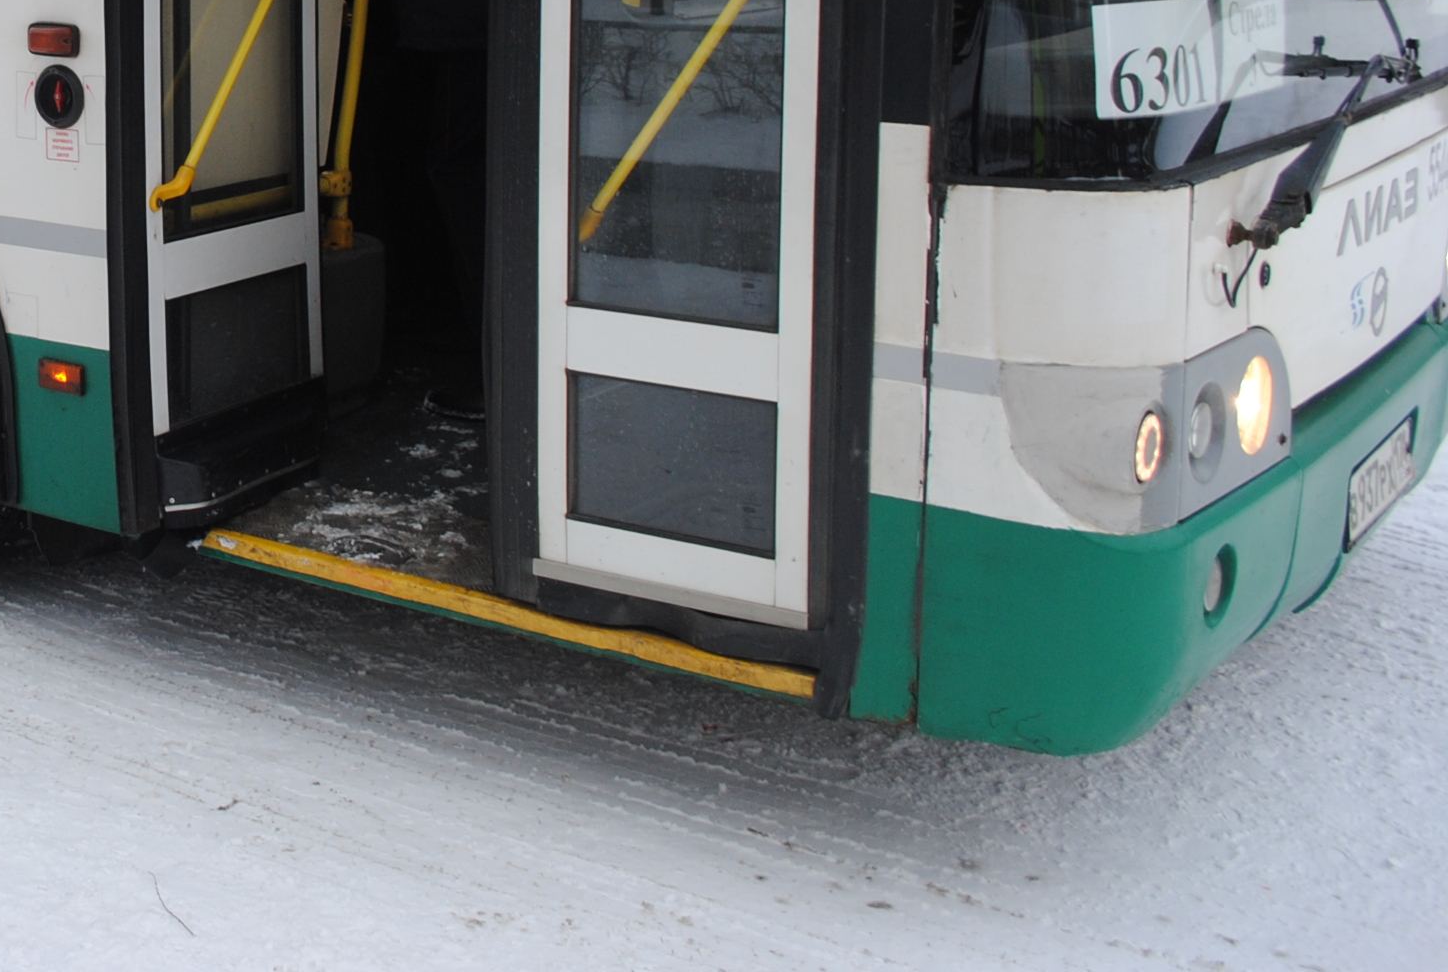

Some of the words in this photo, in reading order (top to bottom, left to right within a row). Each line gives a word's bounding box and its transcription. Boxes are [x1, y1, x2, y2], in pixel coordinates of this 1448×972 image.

[1228, 0, 1278, 42] Стрела
[1109, 43, 1207, 114] 6301
[1336, 166, 1419, 257] ЛИАЗ
